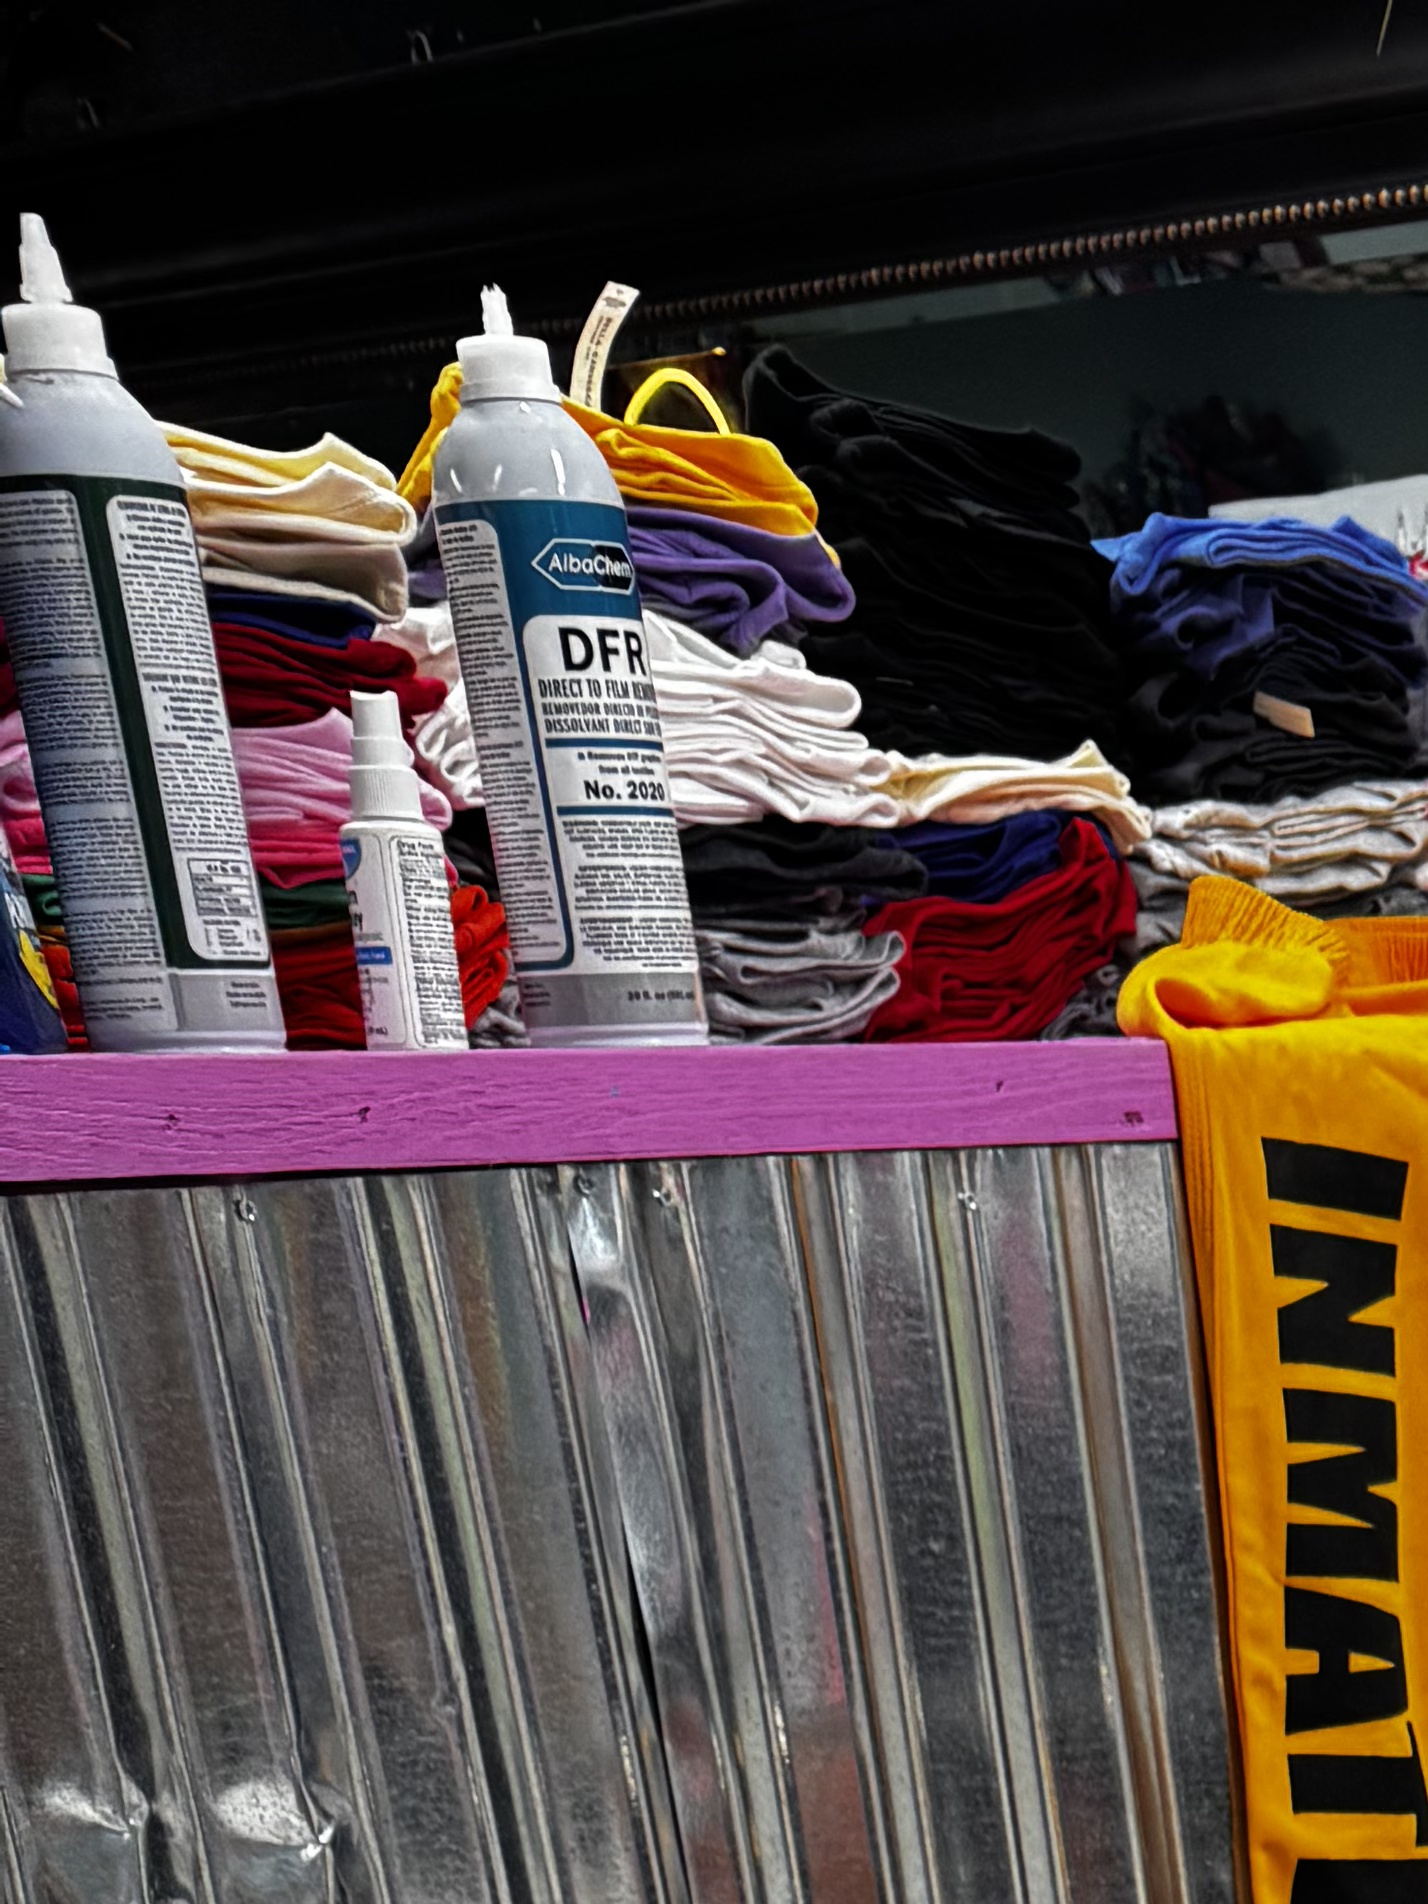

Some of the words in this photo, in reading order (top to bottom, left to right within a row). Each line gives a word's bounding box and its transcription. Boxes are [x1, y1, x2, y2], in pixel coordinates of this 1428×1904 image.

[548, 553, 632, 578] AlbaChem
[558, 627, 647, 677] DFR
[538, 678, 583, 700] DIRECT
[585, 678, 602, 699] TO
[604, 678, 631, 700] FILM
[544, 718, 610, 735] DISSOLVANT
[583, 779, 622, 801] No.
[626, 779, 666, 802] 2020
